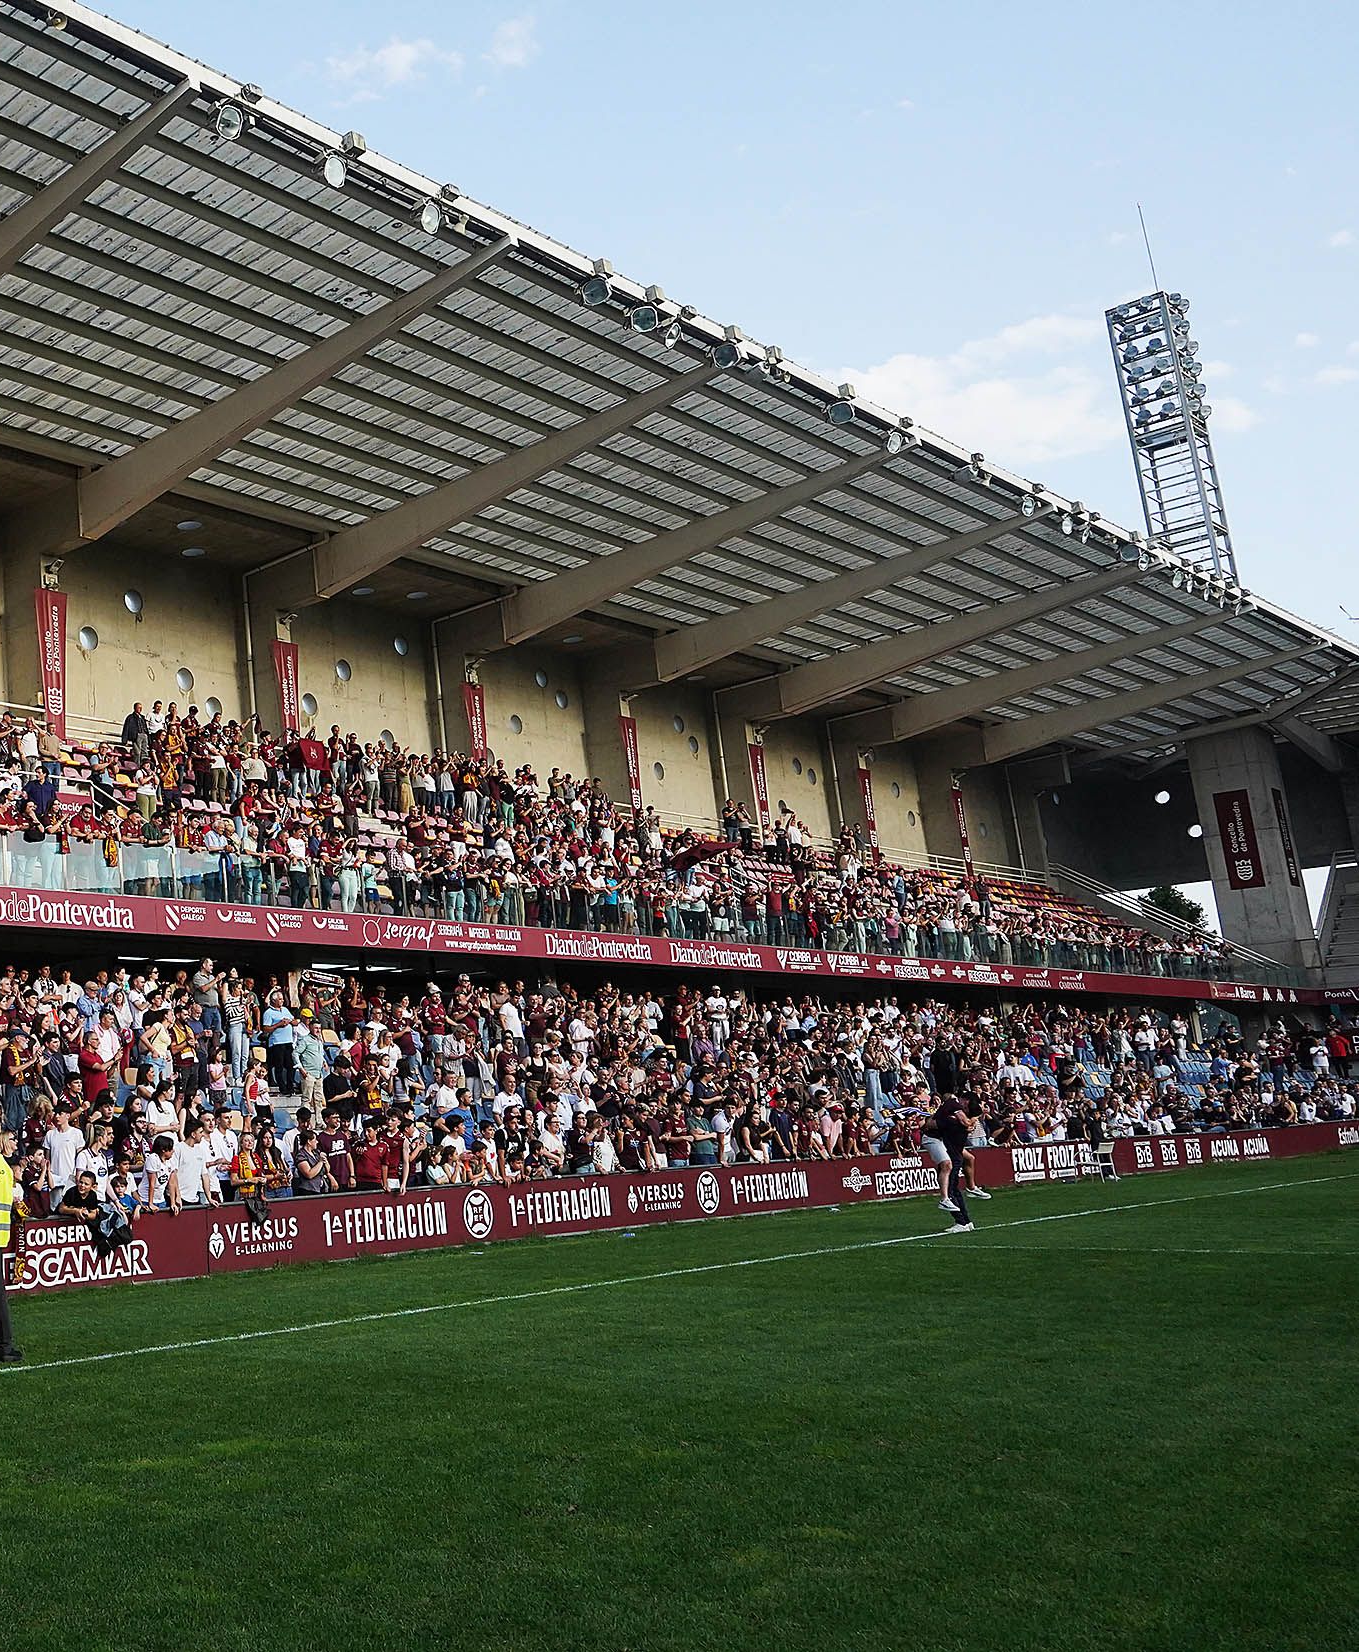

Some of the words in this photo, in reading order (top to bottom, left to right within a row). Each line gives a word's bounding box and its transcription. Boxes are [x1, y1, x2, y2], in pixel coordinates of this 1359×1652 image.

[51, 605, 61, 659] Pontevedra
[45, 630, 53, 672] Concello
[286, 655, 295, 703] Pontevedra
[282, 678, 292, 716] Concello
[1227, 822, 1239, 853] Concello
[180, 905, 207, 914] DEPORTE
[180, 912, 204, 921] GALEGO
[280, 913, 304, 921] DEPORTE
[280, 920, 302, 929] GALEGO
[383, 920, 435, 949] sergraf
[789, 951, 811, 962] CORBA
[890, 1156, 923, 1169] CONSERVAS
[1011, 1147, 1045, 1172] FROIZ
[1047, 1145, 1075, 1169] FROIZ
[639, 1182, 684, 1203] VERSUS
[743, 1167, 809, 1203] FEDERACIÓN
[875, 1167, 941, 1195] PESCAMAR
[473, 1206, 484, 1215] RF
[526, 1182, 611, 1225] FEDERACIÓN
[644, 1200, 682, 1211] E-LEARNING
[226, 1216, 299, 1244] VERSUS
[344, 1197, 448, 1245] FEDERACIÓN
[473, 1214, 484, 1223] EF
[235, 1240, 293, 1256] E-LEARNING
[0, 1240, 154, 1292] ESCAMAR
